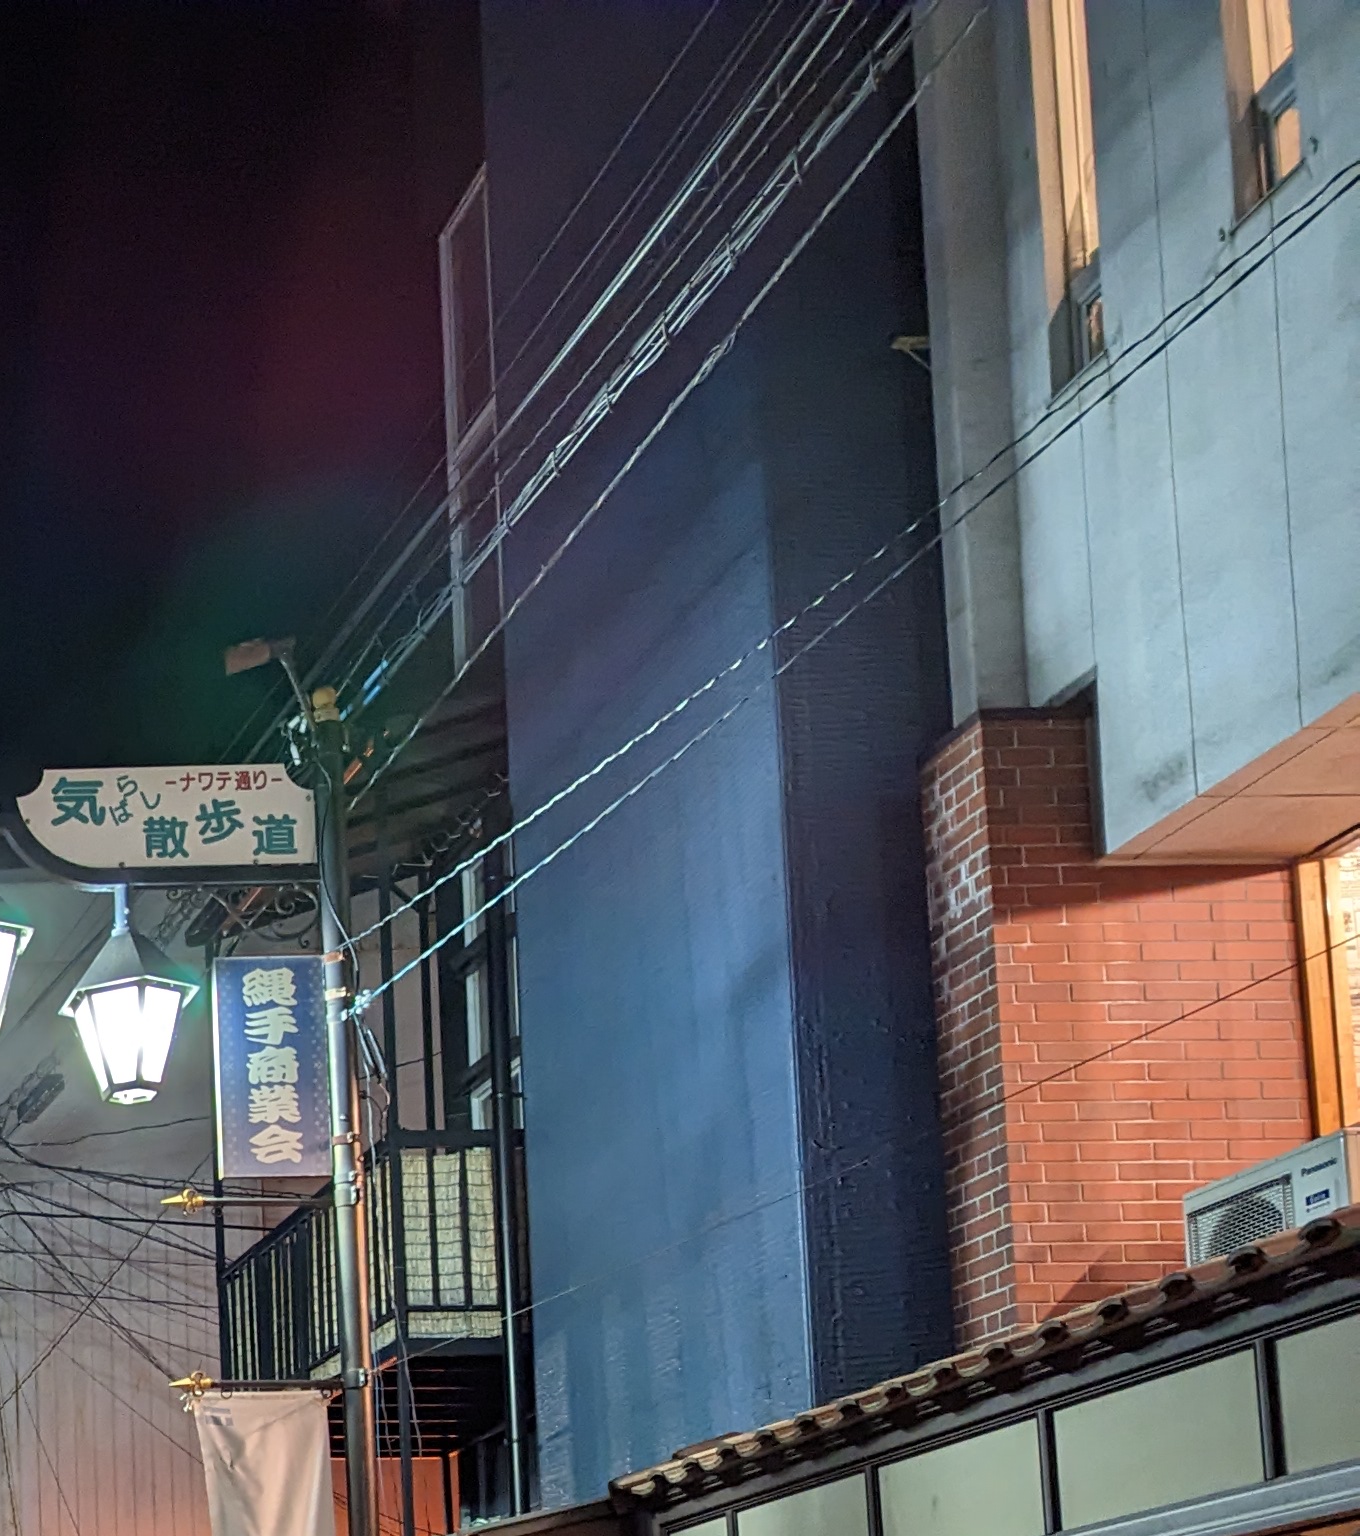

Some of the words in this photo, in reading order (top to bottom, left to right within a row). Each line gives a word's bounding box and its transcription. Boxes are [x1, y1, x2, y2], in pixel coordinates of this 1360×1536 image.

[142, 798, 299, 860] 散歩道
[241, 966, 304, 1166] 縄手商業会
